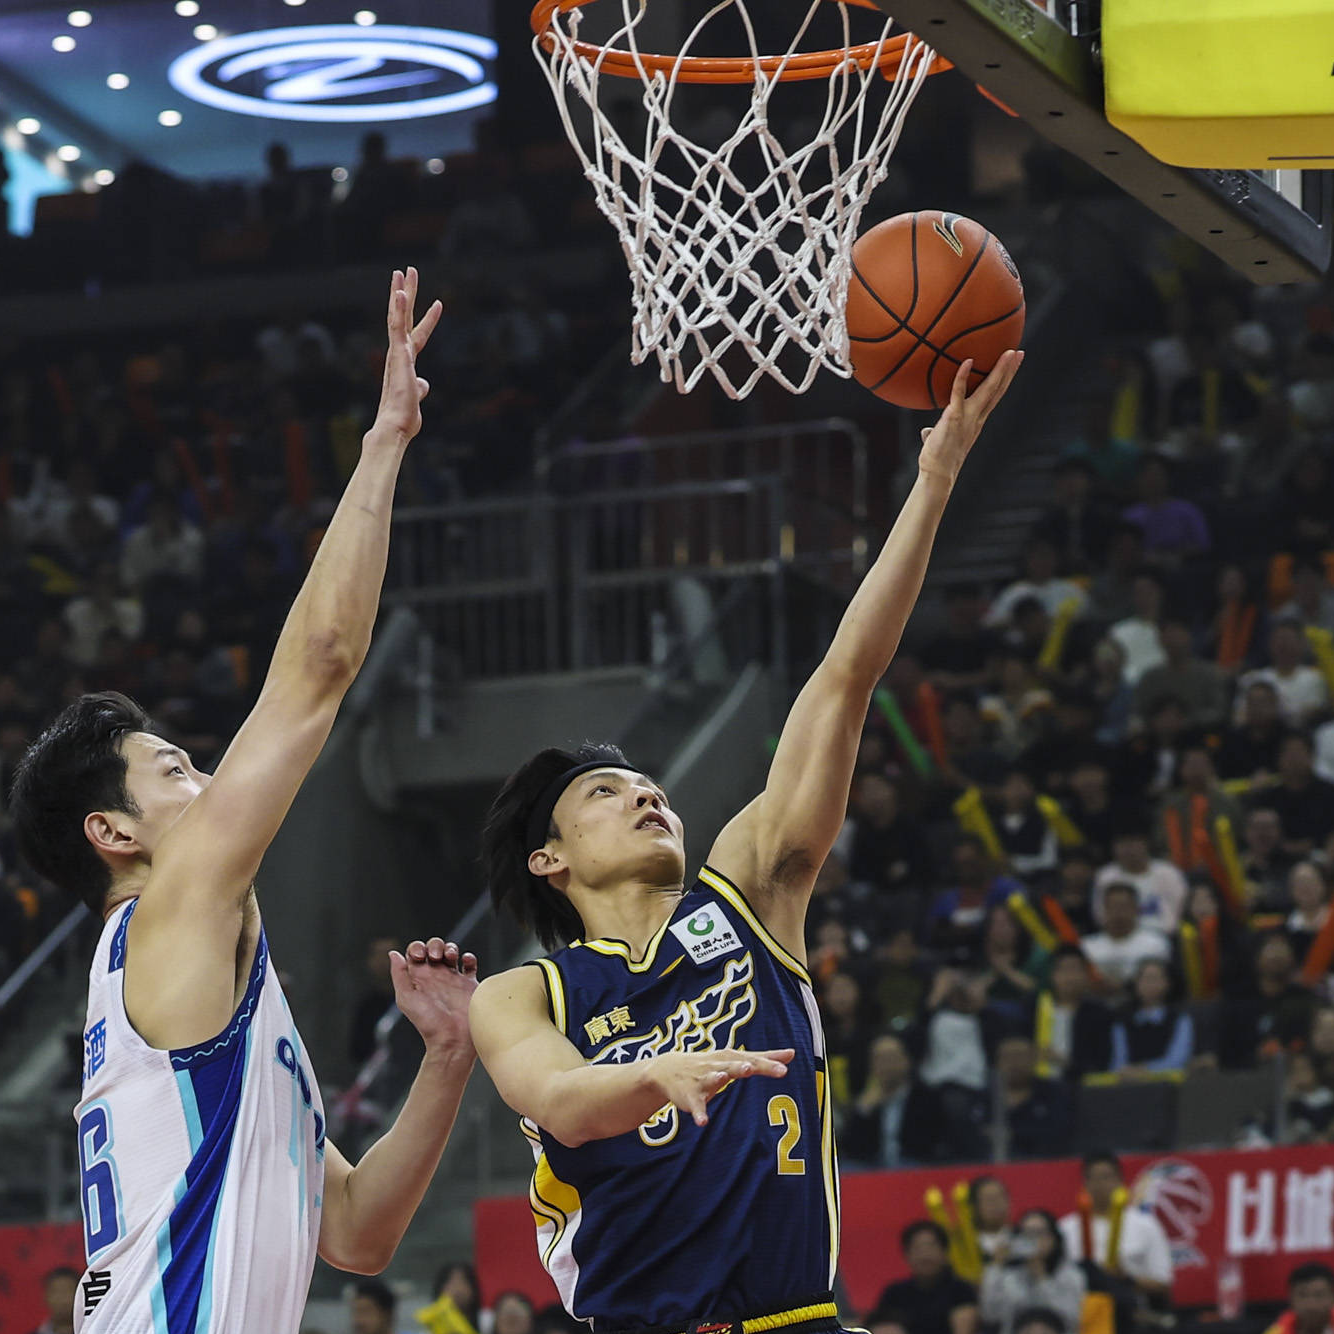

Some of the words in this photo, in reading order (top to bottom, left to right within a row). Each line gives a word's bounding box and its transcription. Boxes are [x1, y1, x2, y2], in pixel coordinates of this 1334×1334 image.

[691, 932, 732, 952] 中国人寿
[696, 946, 719, 959] CHINA
[719, 939, 736, 950] LIFE
[584, 1005, 636, 1046] 廣東
[767, 1094, 805, 1176] 2
